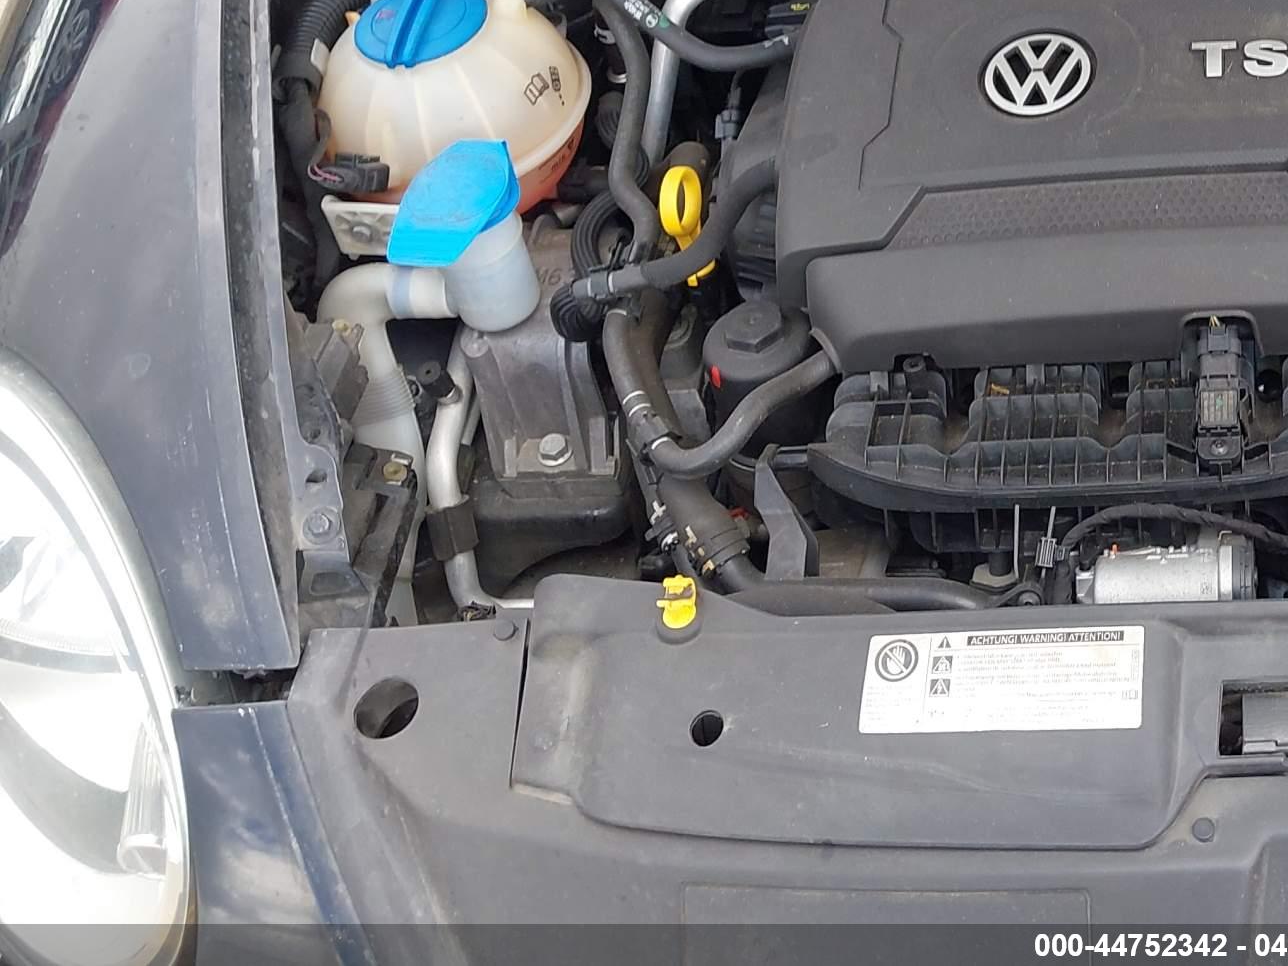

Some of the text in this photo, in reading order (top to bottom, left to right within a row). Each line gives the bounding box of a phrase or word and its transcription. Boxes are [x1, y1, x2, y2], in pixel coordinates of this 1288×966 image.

[970, 631, 1122, 646] ACHTUNG! WARNING! ATTENTION!
